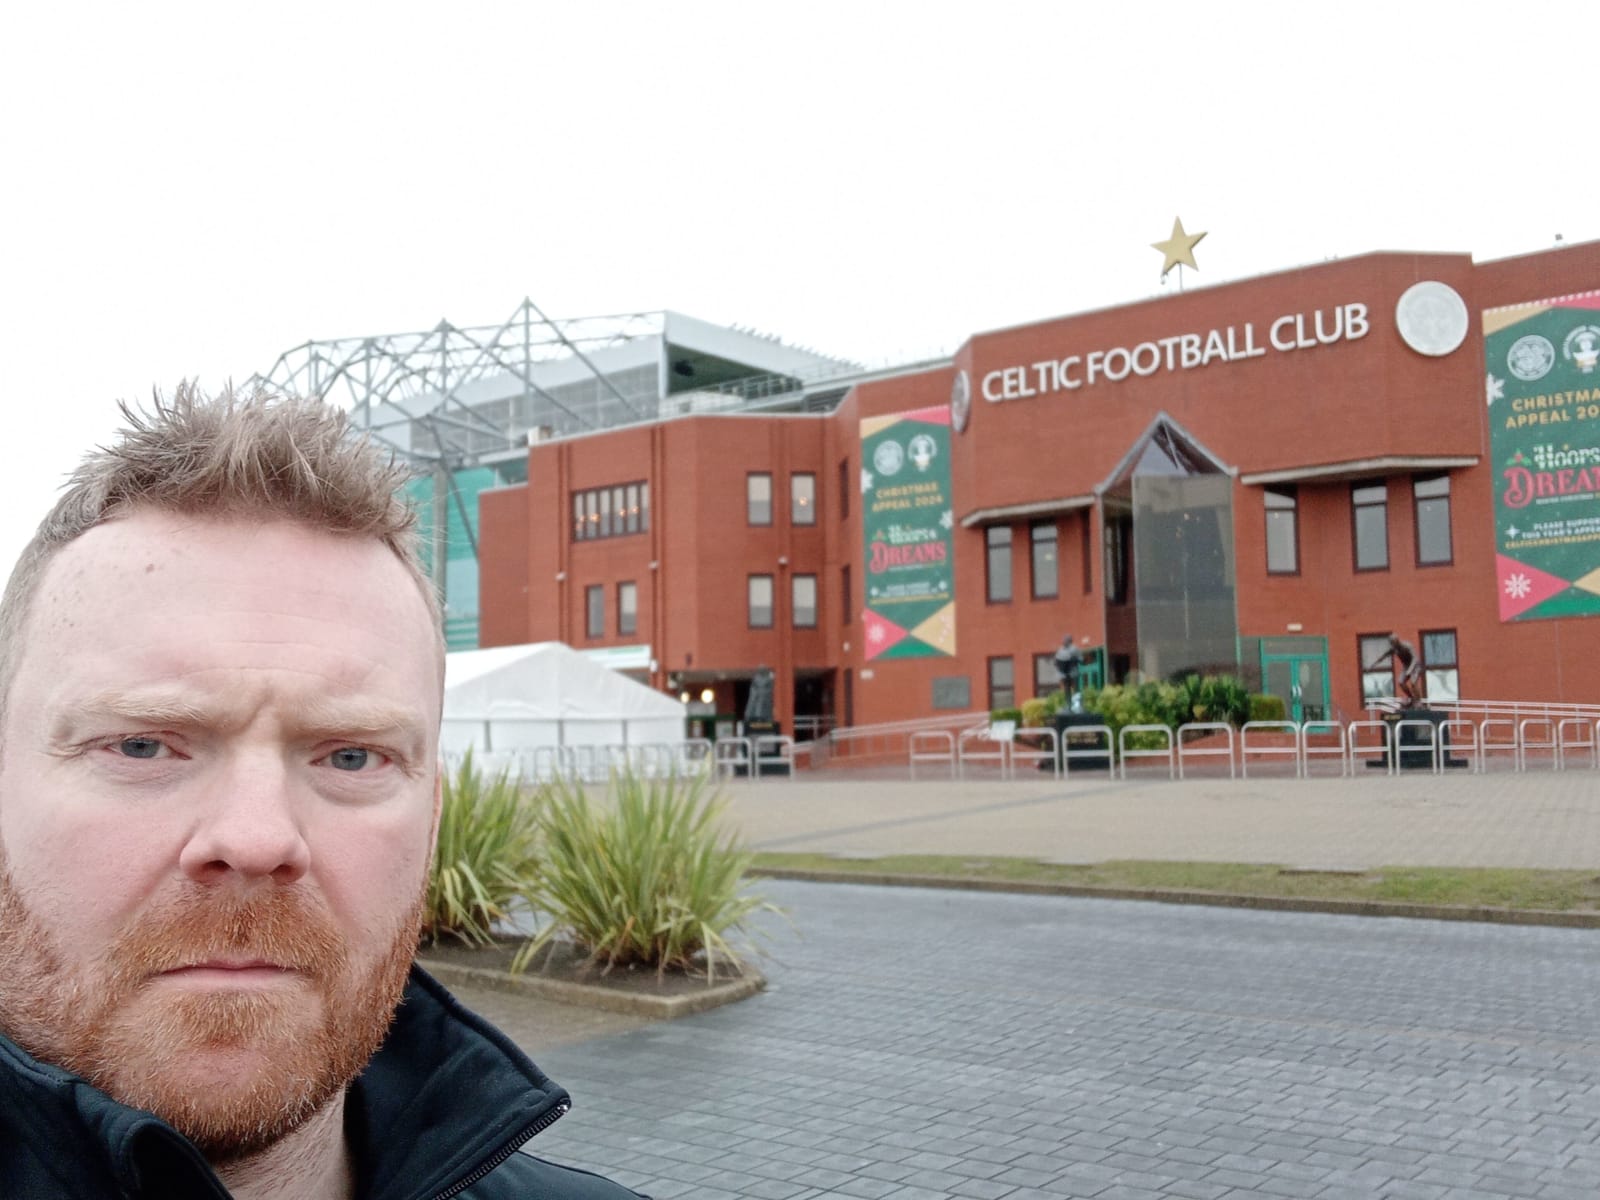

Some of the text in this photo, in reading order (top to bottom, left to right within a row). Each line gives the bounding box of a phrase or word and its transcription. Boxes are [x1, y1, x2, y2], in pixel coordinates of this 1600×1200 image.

[982, 303, 1369, 402] CELTIC FOOTBALL CLUB
[1505, 409, 1571, 429] APPEAL
[869, 541, 946, 573] DREAMS
